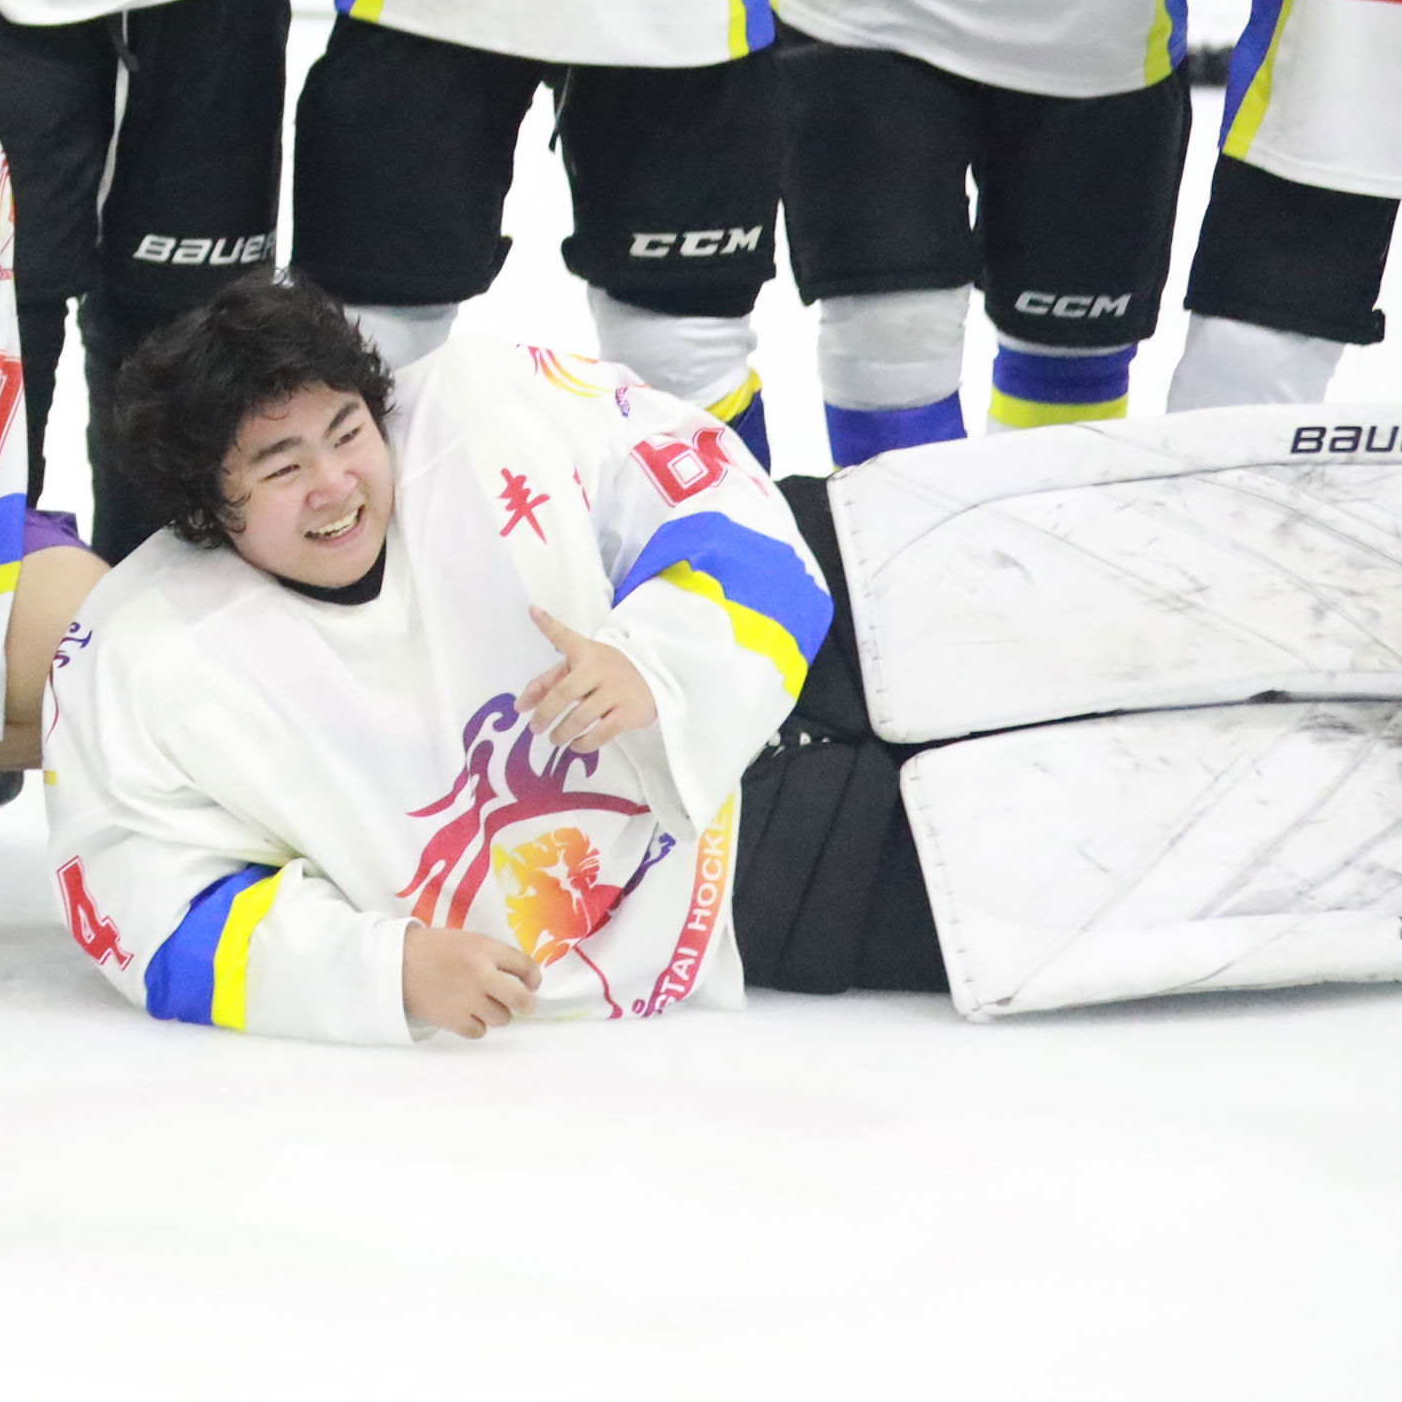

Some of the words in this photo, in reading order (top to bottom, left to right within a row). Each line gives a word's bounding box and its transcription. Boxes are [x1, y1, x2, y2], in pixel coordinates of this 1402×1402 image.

[628, 225, 763, 259] CCM
[1014, 291, 1133, 319] CCM
[1290, 425, 1402, 455] BAU
